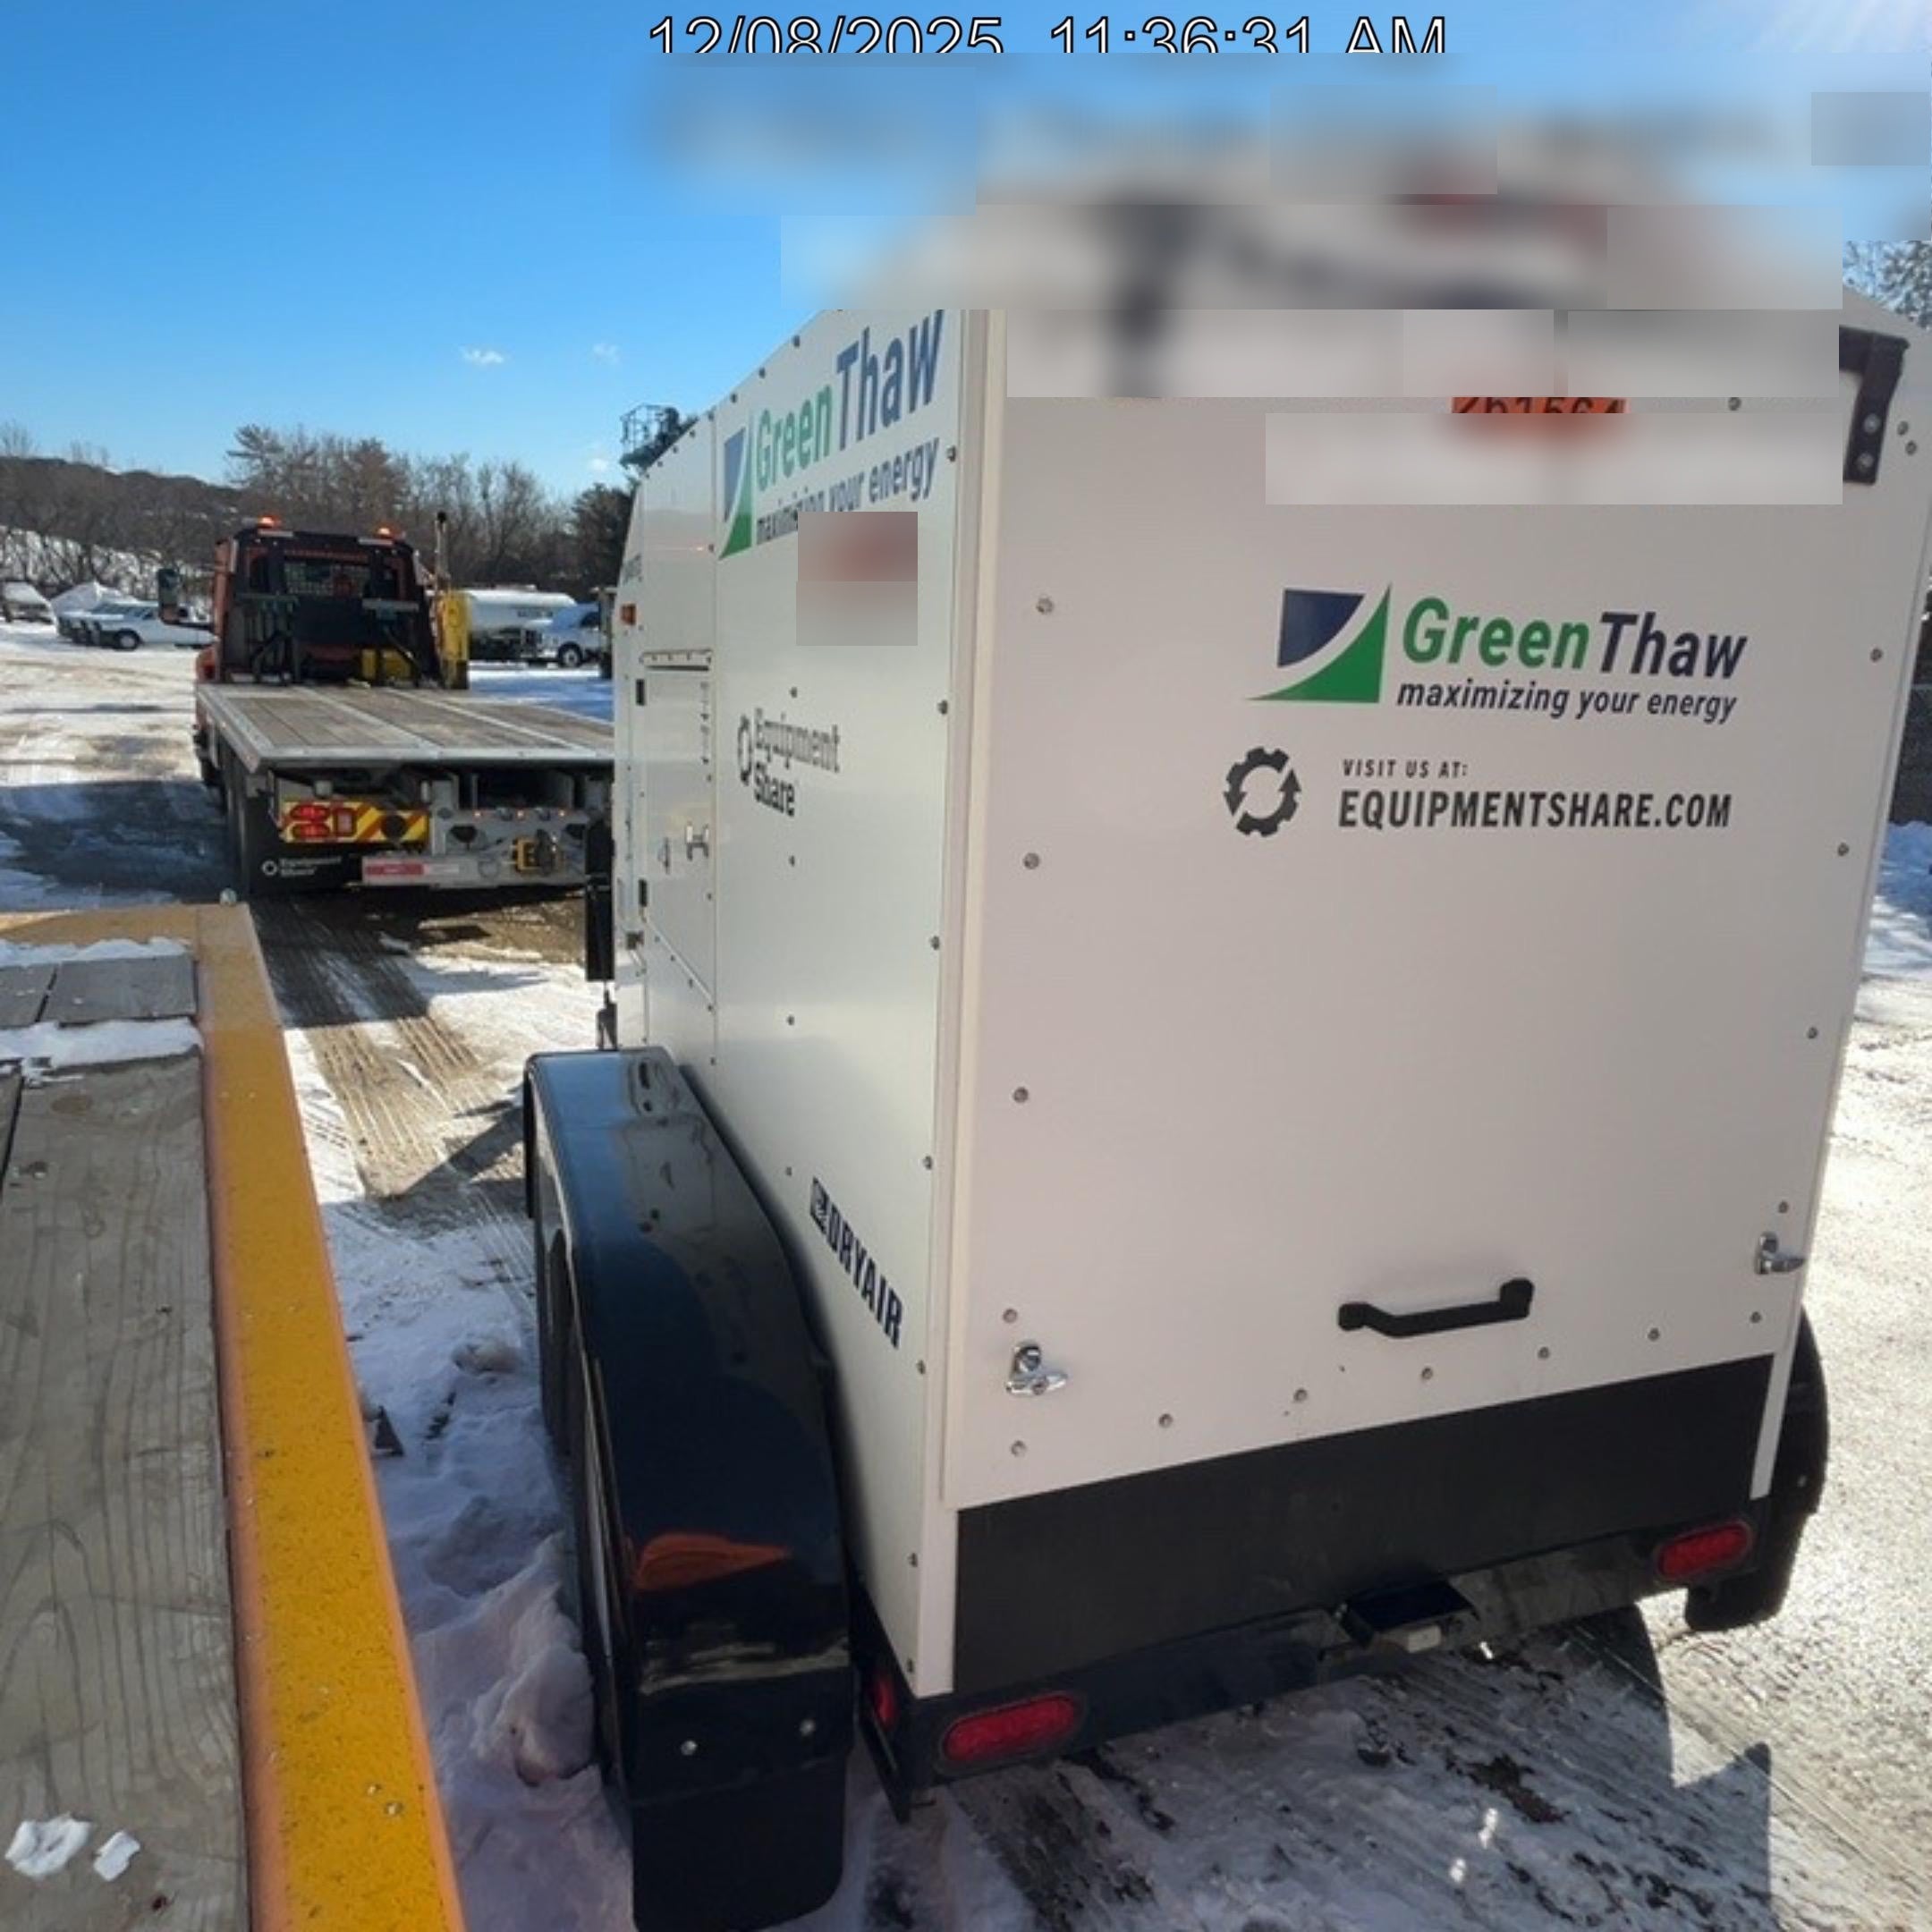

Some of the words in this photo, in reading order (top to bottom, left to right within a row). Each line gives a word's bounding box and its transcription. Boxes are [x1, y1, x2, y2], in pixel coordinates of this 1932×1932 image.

[869, 436, 939, 501] energy
[1397, 677, 1569, 719] maximizing
[1576, 688, 1640, 719] your
[1647, 693, 1737, 726] energy
[1343, 759, 1396, 777] VISIT
[1405, 760, 1429, 778] US
[1437, 761, 1469, 778] AT:
[1338, 791, 1733, 830] EQUIPMENTSHARE.COM
[827, 1203, 903, 1351] DRYAIR
